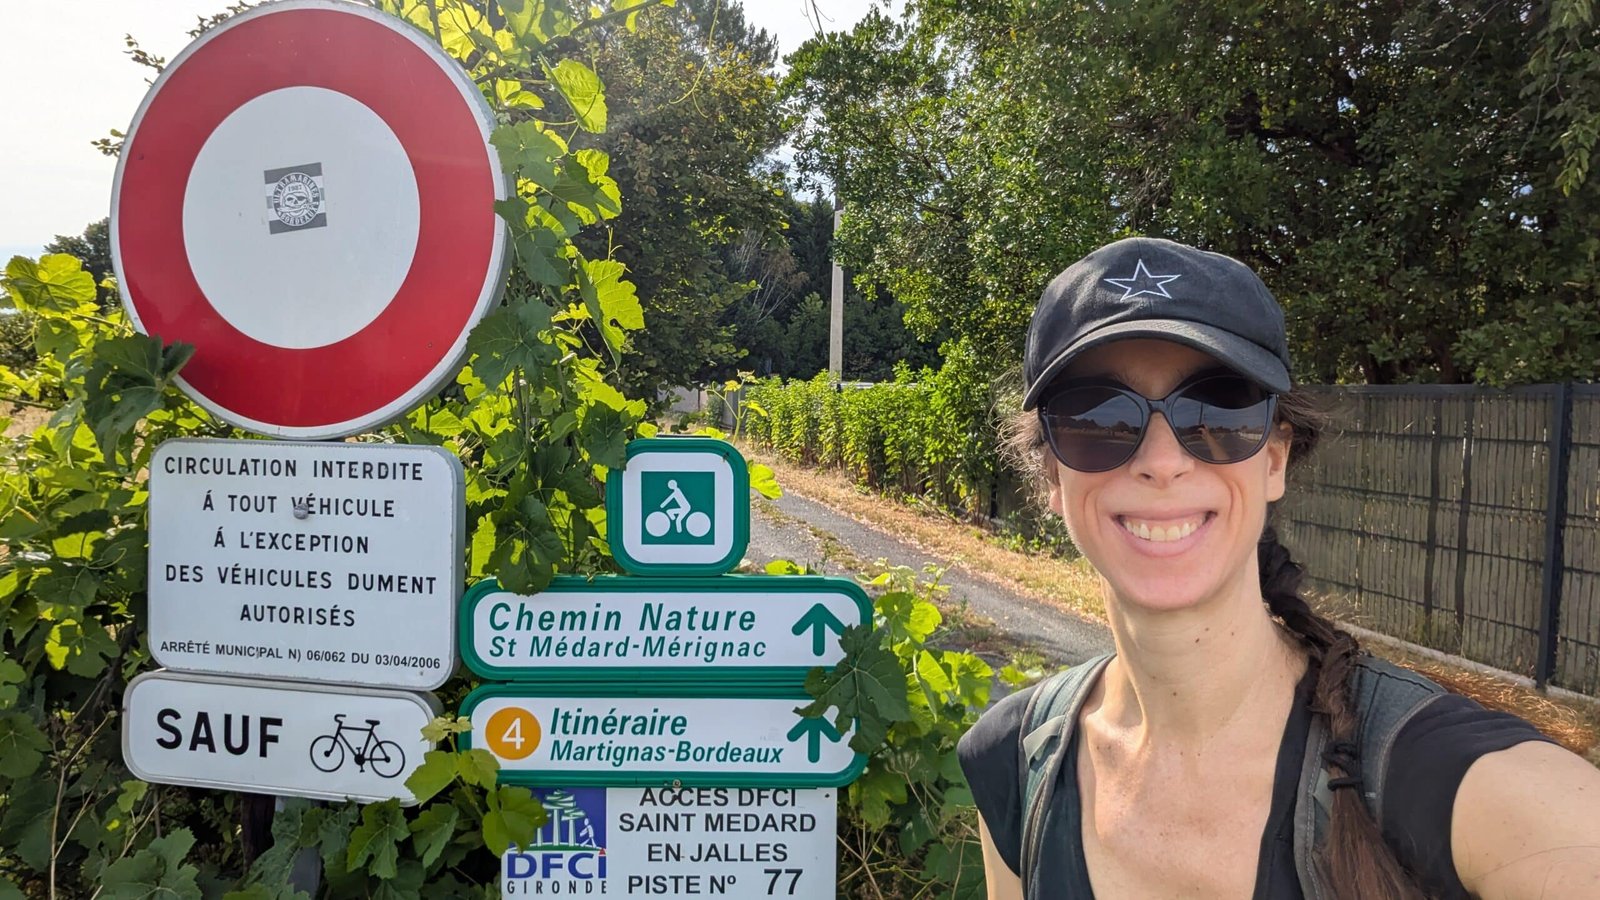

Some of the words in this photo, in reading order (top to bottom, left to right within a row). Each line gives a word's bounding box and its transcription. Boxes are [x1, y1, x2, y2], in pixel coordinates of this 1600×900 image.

[164, 456, 297, 477] CIRCULATION
[313, 460, 423, 481] INTERDITE
[202, 489, 214, 511] Á
[228, 494, 277, 513] TOUT
[291, 493, 395, 518] VÉHICULE
[214, 526, 225, 548] Á
[240, 531, 369, 554] L'EXCEPTION
[165, 564, 203, 583] DES
[217, 563, 332, 589] VÉHICULES
[348, 573, 437, 595] DUMENT
[240, 604, 355, 627] AUTORISÉS
[489, 602, 622, 632] Chemin
[639, 602, 756, 632] Nature
[160, 640, 210, 655] ARRÊTÉ
[215, 643, 283, 660] MUNICIPAL
[306, 650, 346, 664] 06/062
[351, 652, 369, 664] DU
[375, 654, 441, 670] 03/04/2006
[489, 636, 517, 658] St
[529, 635, 767, 663] Médard-Mérignac
[155, 708, 283, 758] SAUF
[501, 716, 525, 750] 4
[550, 707, 688, 736] Itinéraire
[550, 739, 784, 767] Martignas-Bordeaux
[639, 788, 729, 807] ACCES
[738, 788, 796, 807] DFCI
[618, 813, 696, 832] SAINT
[704, 813, 816, 832] MEDARD
[648, 843, 681, 862] EN
[690, 843, 788, 863] JALLES
[507, 880, 607, 895] GIRONDE
[628, 875, 700, 894] PISTE
[763, 868, 803, 895] 77
